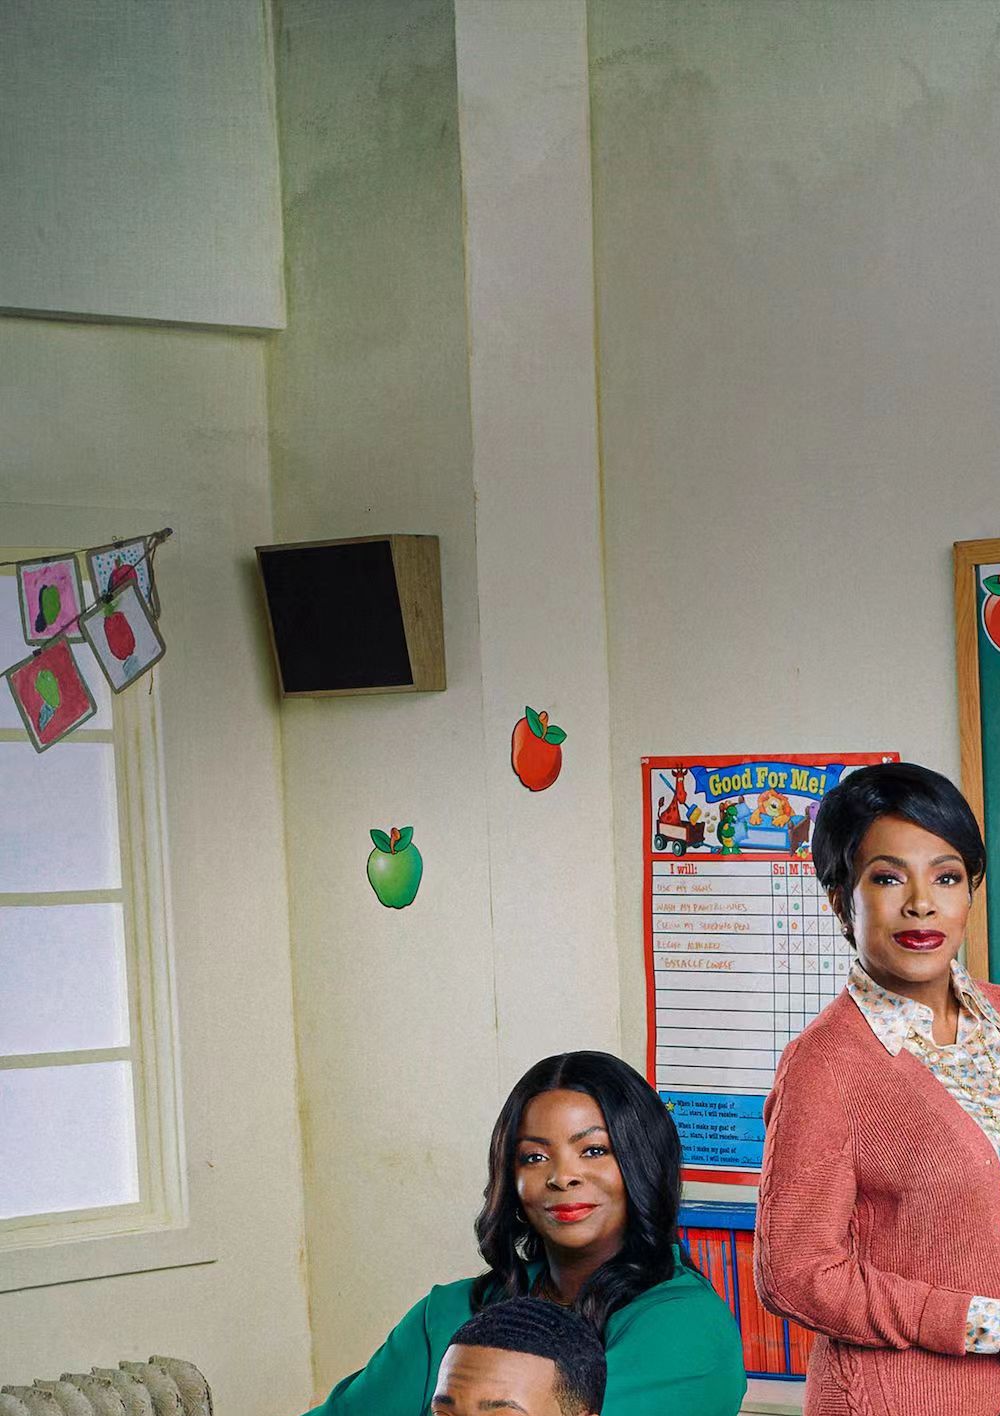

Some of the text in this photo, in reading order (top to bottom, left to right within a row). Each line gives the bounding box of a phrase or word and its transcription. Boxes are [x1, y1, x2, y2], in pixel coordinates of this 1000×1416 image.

[709, 766, 826, 796] Good For Me!
[670, 864, 698, 875] I will:
[773, 864, 785, 874] Su
[790, 864, 799, 875] M
